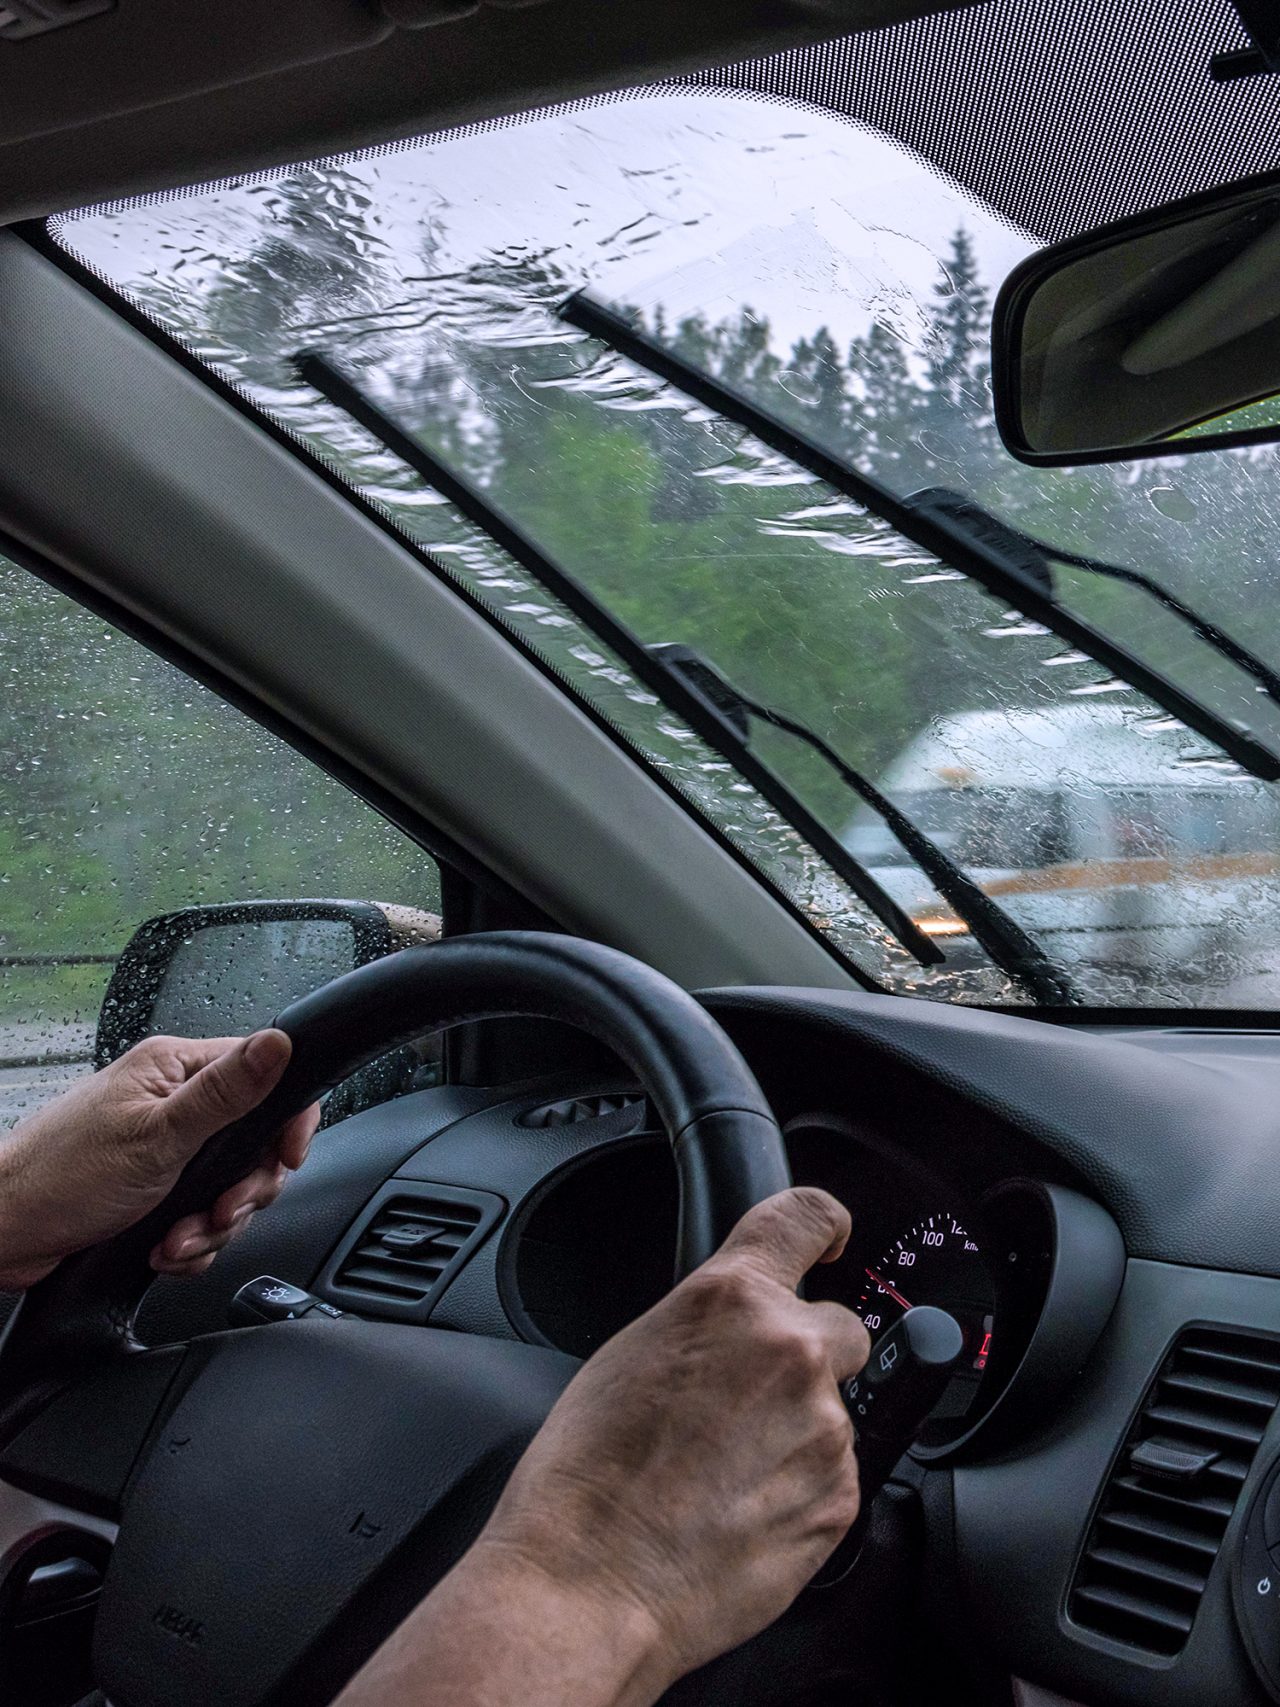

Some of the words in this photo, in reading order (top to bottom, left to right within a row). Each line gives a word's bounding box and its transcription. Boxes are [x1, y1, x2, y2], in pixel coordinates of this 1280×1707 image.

[922, 1230, 944, 1246] 100
[898, 1251, 916, 1266] 80
[864, 1314, 881, 1329] 40
